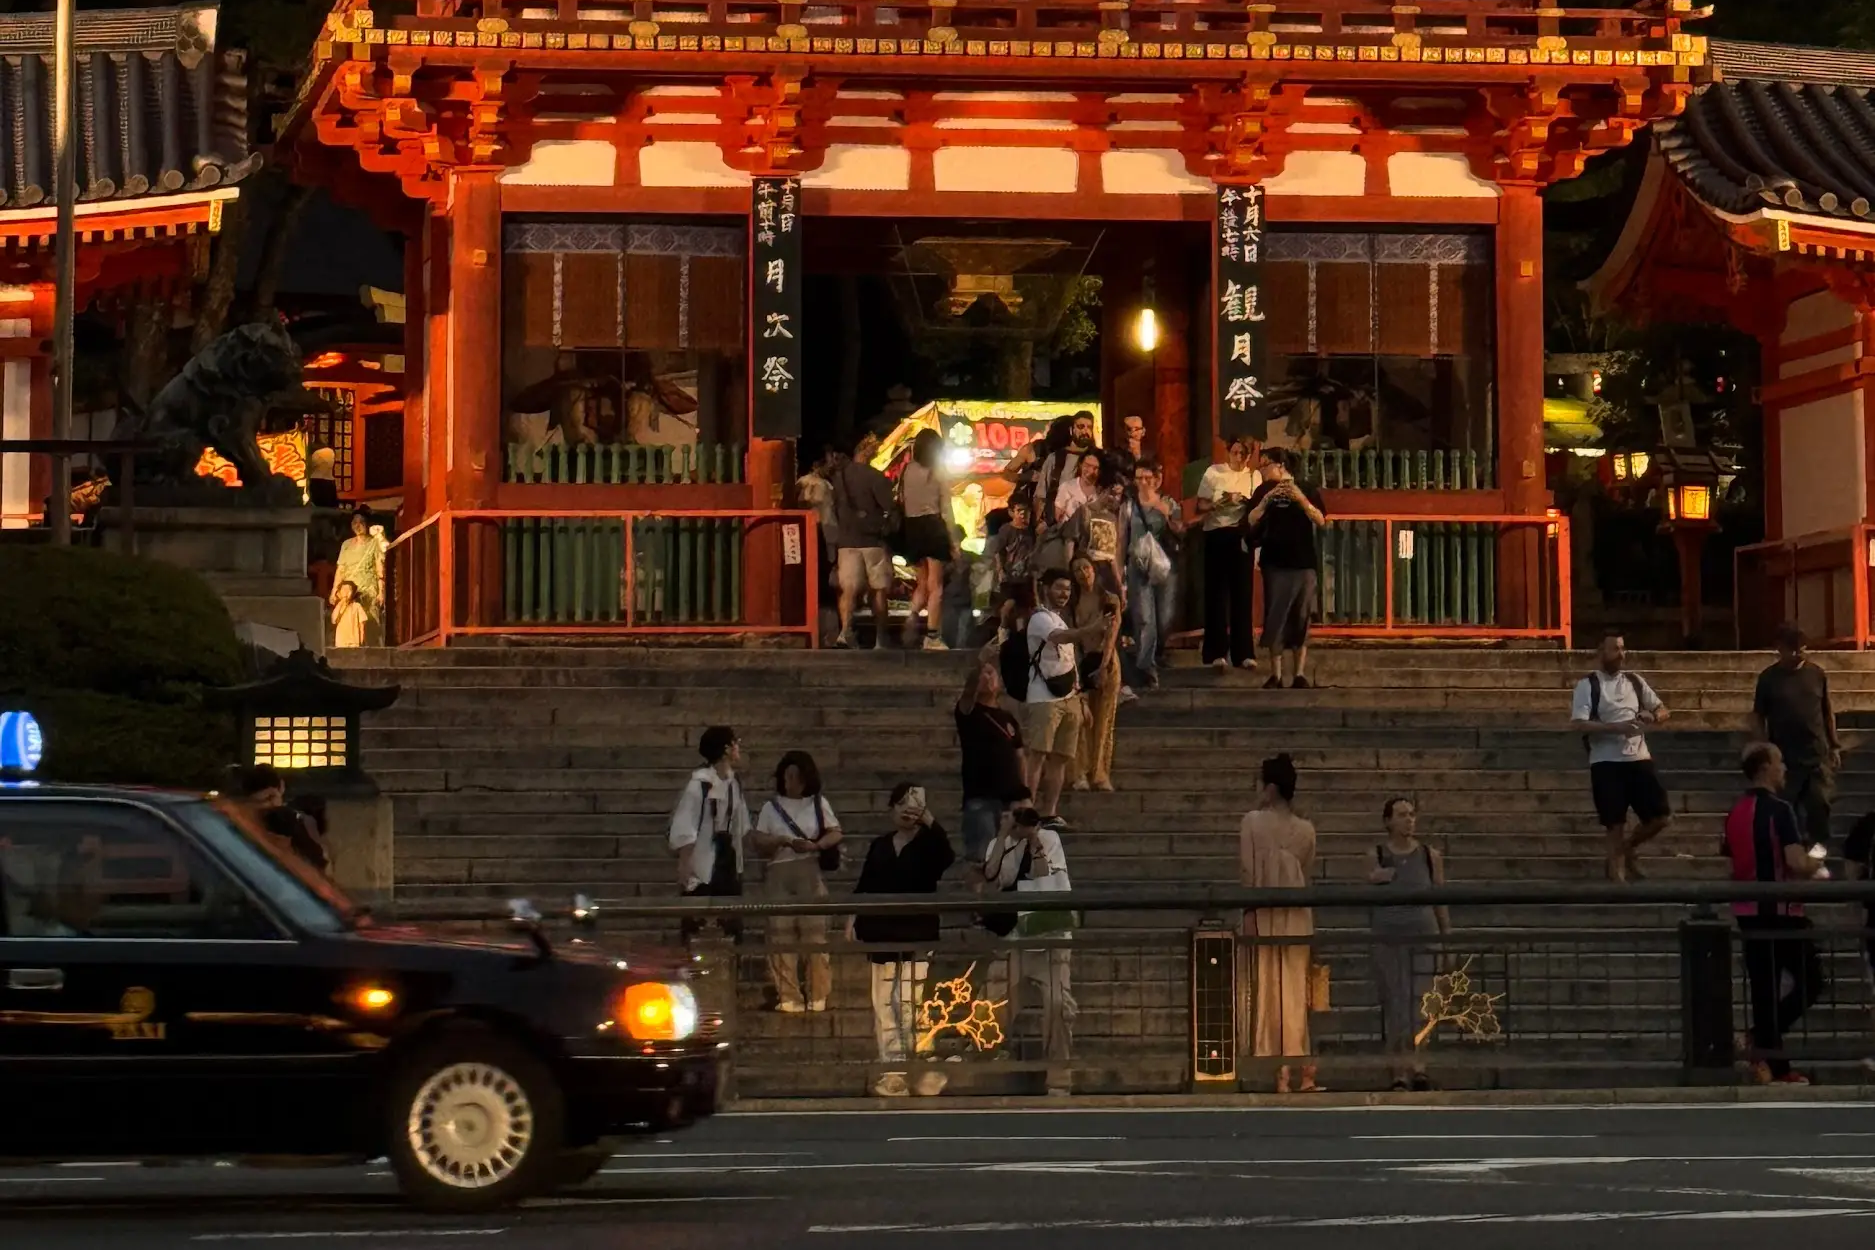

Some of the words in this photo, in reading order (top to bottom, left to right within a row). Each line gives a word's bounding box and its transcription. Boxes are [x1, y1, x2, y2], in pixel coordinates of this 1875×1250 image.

[1242, 185, 1262, 263] 十月六日
[761, 258, 794, 393] 月次祭
[1220, 278, 1265, 412] 観月祭
